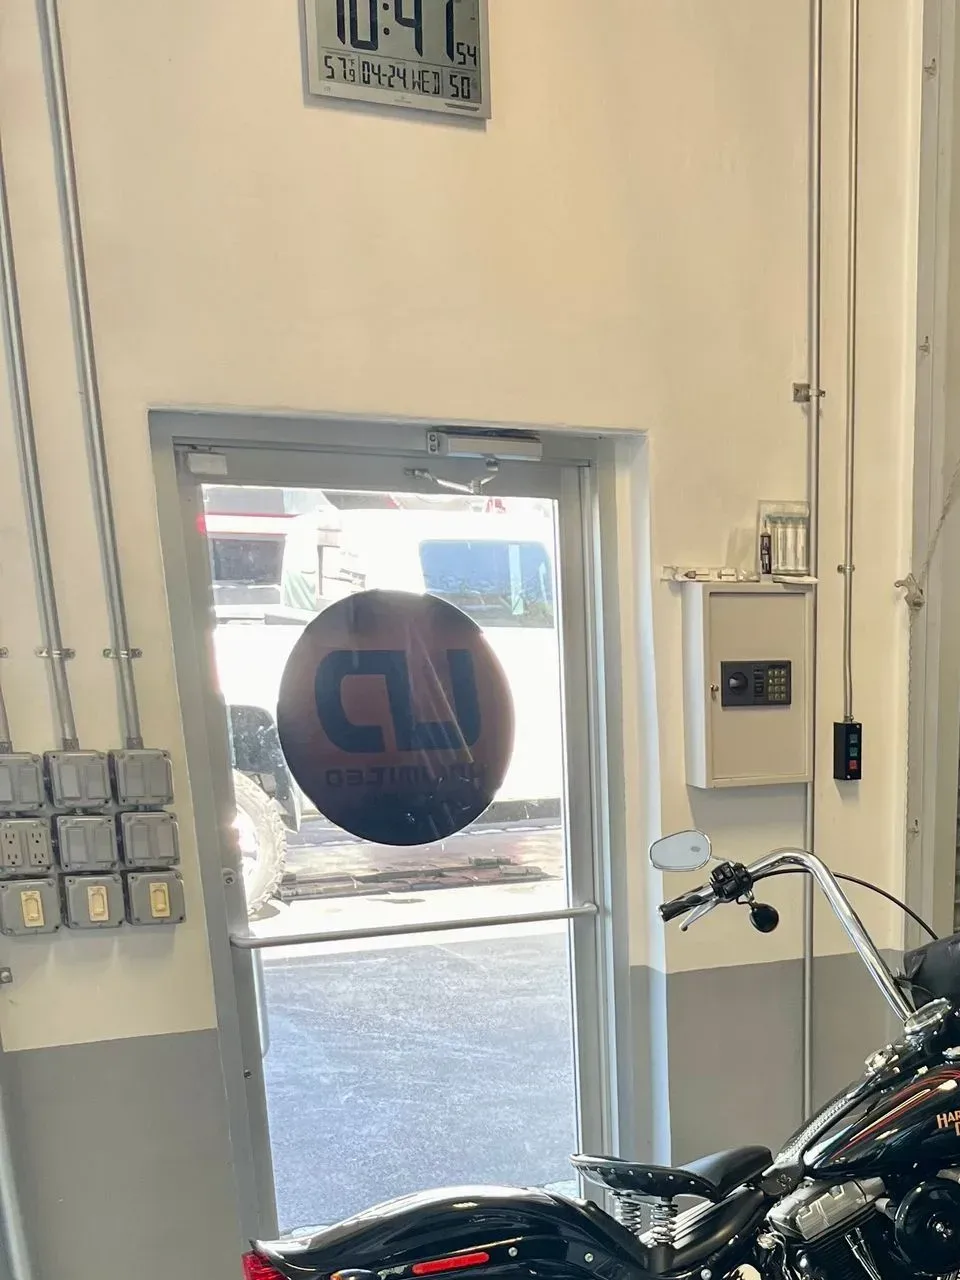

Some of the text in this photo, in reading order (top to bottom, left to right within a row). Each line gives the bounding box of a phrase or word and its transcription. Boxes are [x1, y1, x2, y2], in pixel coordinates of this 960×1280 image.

[456, 42, 477, 67] 54
[411, 70, 440, 95] WED
[450, 77, 470, 99] 50
